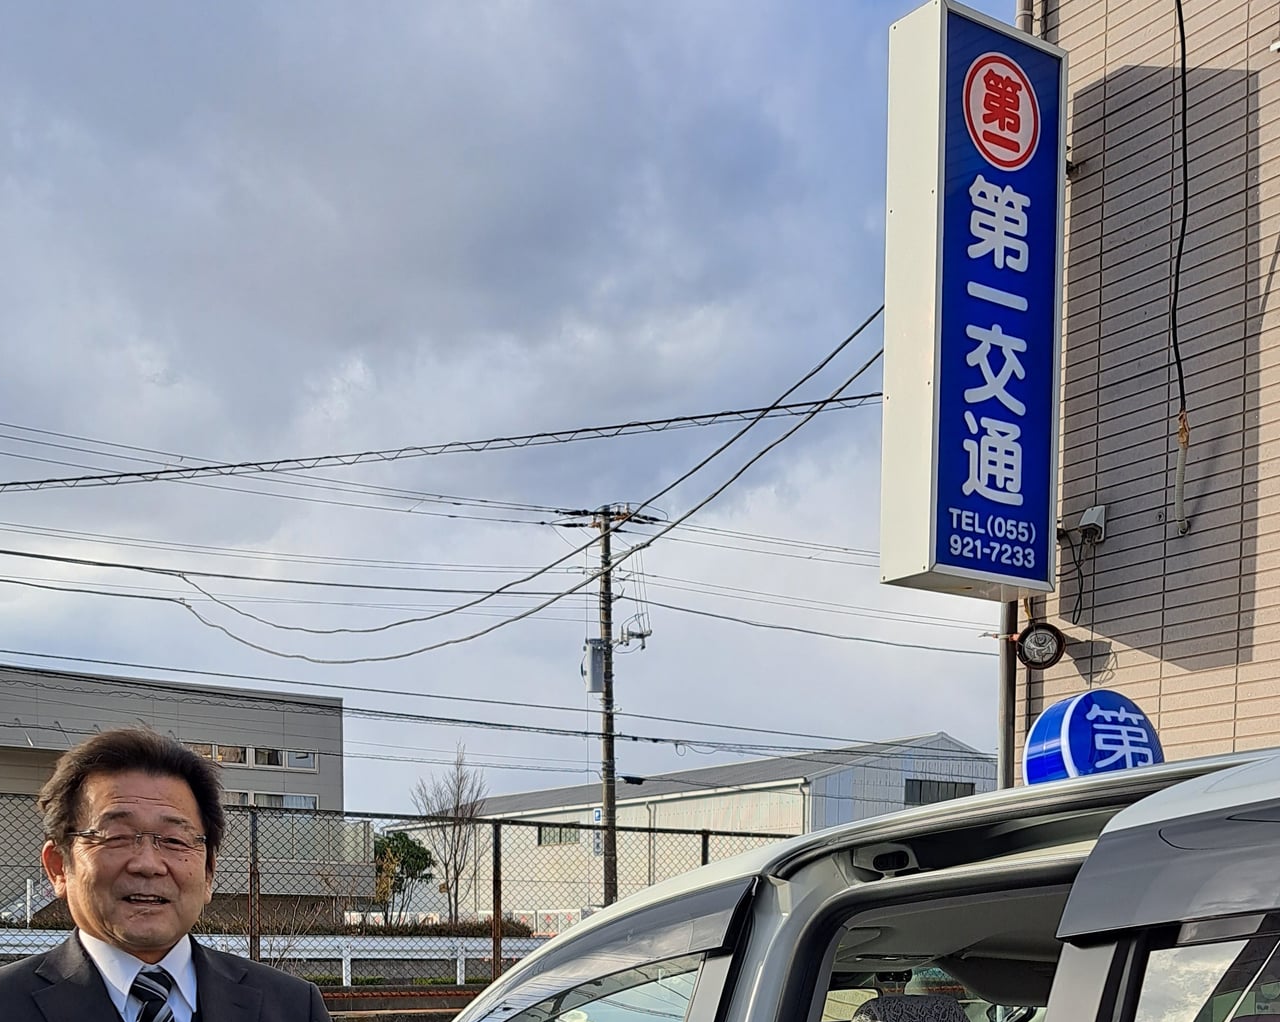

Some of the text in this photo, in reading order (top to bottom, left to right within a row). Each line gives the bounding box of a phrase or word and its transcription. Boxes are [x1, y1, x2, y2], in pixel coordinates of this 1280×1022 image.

[962, 174, 1030, 506] 第一交通
[949, 507, 1035, 544] TEL(055)
[950, 534, 1034, 568] 921-7233
[1086, 704, 1153, 769] 第
